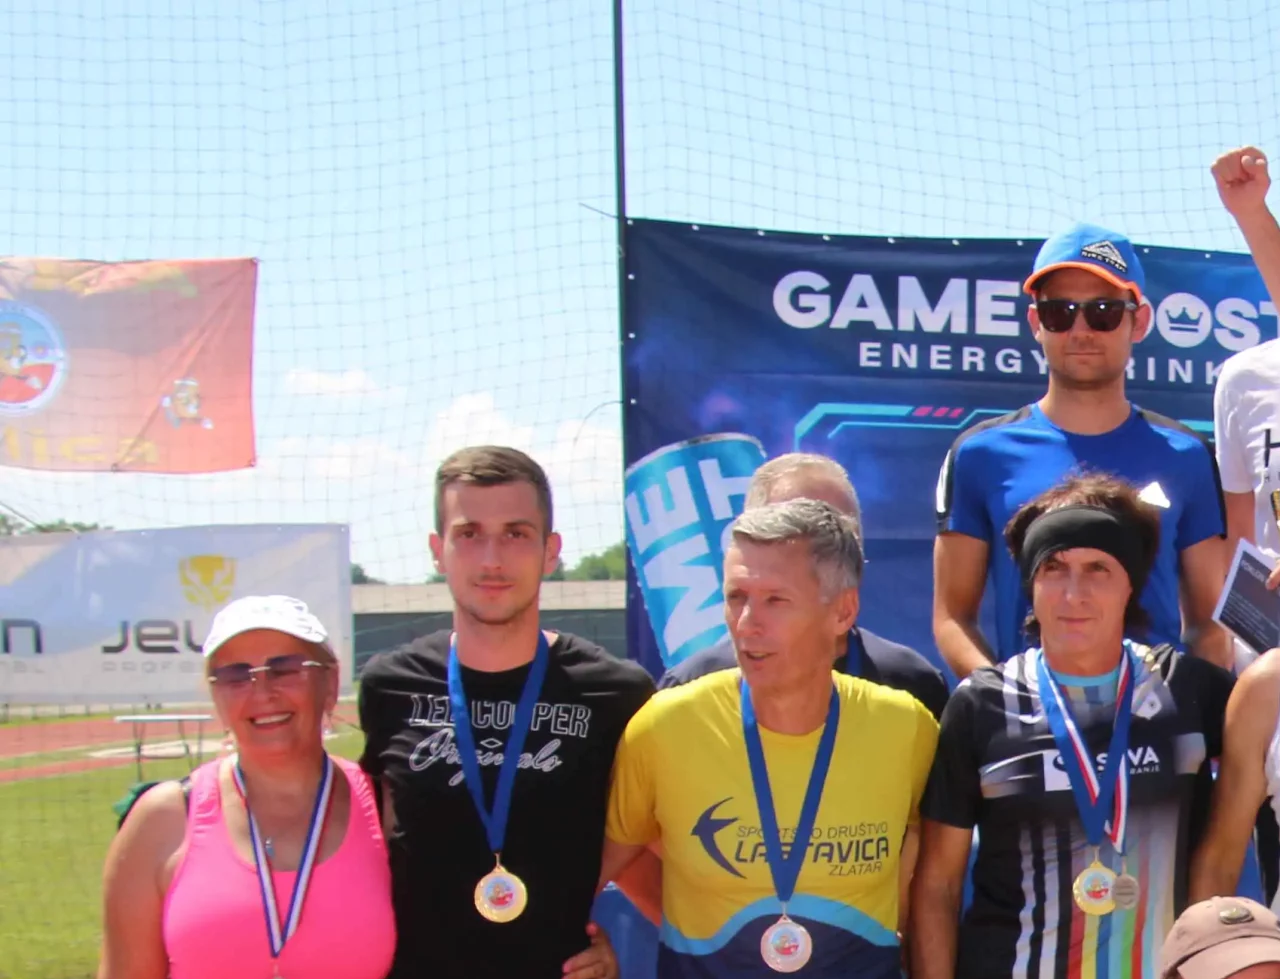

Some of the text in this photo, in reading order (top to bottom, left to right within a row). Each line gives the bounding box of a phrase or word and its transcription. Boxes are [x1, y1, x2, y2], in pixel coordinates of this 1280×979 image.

[772, 270, 1021, 337] GAME
[858, 341, 1224, 386] ENERGY RINK
[470, 699, 593, 738] COPER
[1095, 745, 1161, 773] SVA
[736, 820, 889, 840] SPTSO DRUŠTVO
[828, 860, 884, 878] ZLATAR
